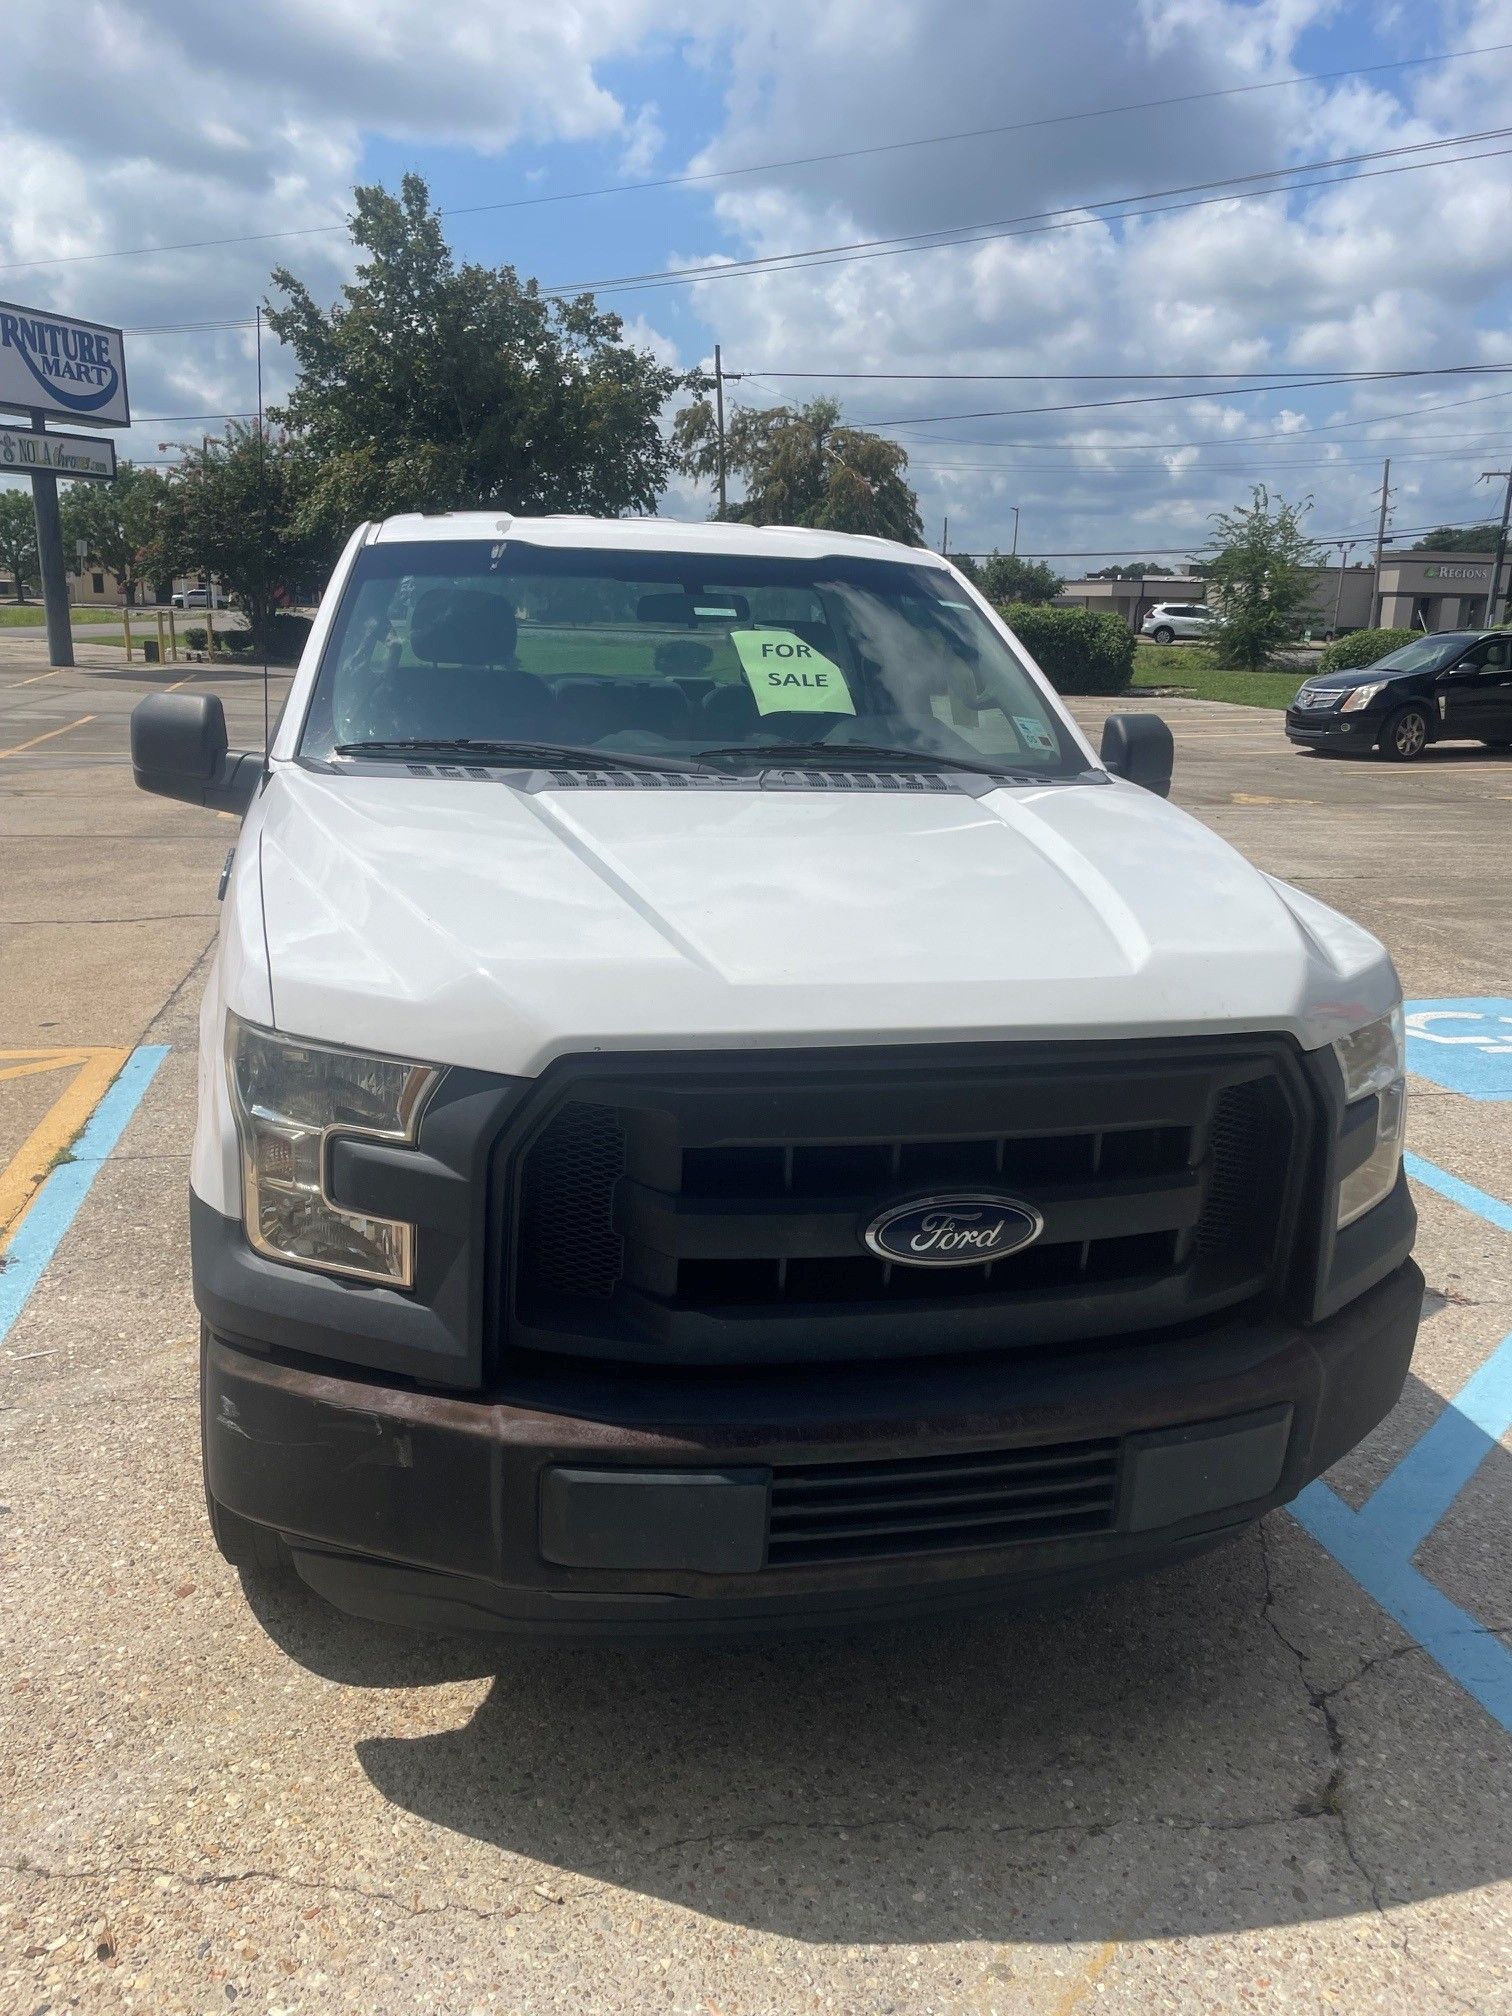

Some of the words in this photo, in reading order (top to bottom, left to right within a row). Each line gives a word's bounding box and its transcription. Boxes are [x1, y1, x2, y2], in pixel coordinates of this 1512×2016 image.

[41, 355, 109, 386] MART
[1439, 566, 1487, 578] REGIONS
[761, 643, 812, 658] FOR
[768, 672, 829, 688] SALE
[910, 1212, 1006, 1252] Ford
